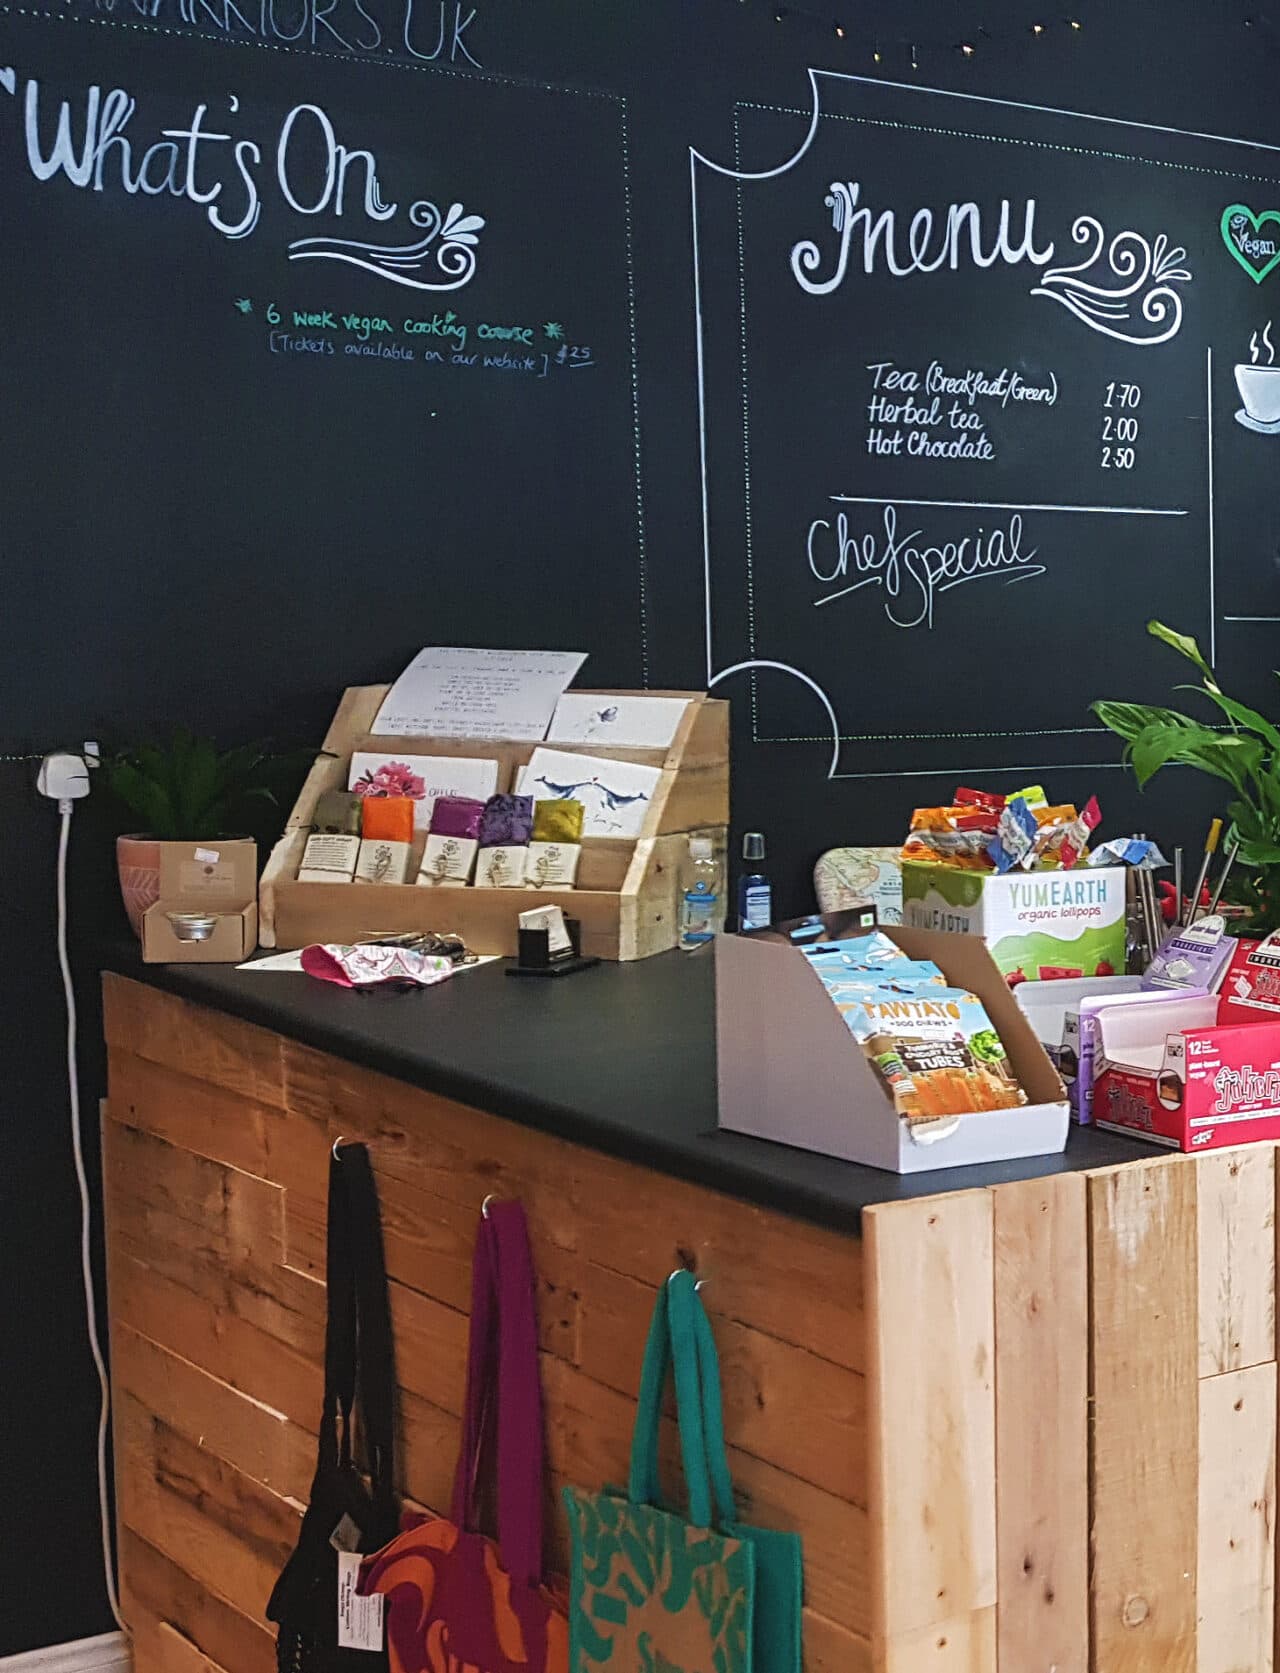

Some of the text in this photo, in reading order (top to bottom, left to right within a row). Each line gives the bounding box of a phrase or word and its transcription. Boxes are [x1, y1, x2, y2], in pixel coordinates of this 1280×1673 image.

[25, 79, 397, 239] What's On
[1231, 231, 1276, 259] Vegan
[266, 303, 280, 324] 6
[293, 311, 337, 329] week
[342, 313, 393, 341] vegan
[403, 311, 467, 352] cooking
[344, 342, 415, 361] available
[425, 351, 445, 362] on
[451, 353, 477, 367] our
[866, 362, 921, 392] Tea
[868, 395, 943, 426] Herbal
[948, 400, 985, 430] tea
[866, 427, 903, 455] Hot
[907, 431, 996, 460] Chocolate
[807, 505, 923, 596] Chef
[1009, 879, 1108, 909] YUMEARTH
[1017, 905, 1101, 923] organic lollipops
[1083, 1019, 1096, 1032] 12
[914, 1055, 965, 1070] TUBES
[1188, 1040, 1202, 1055] 12
